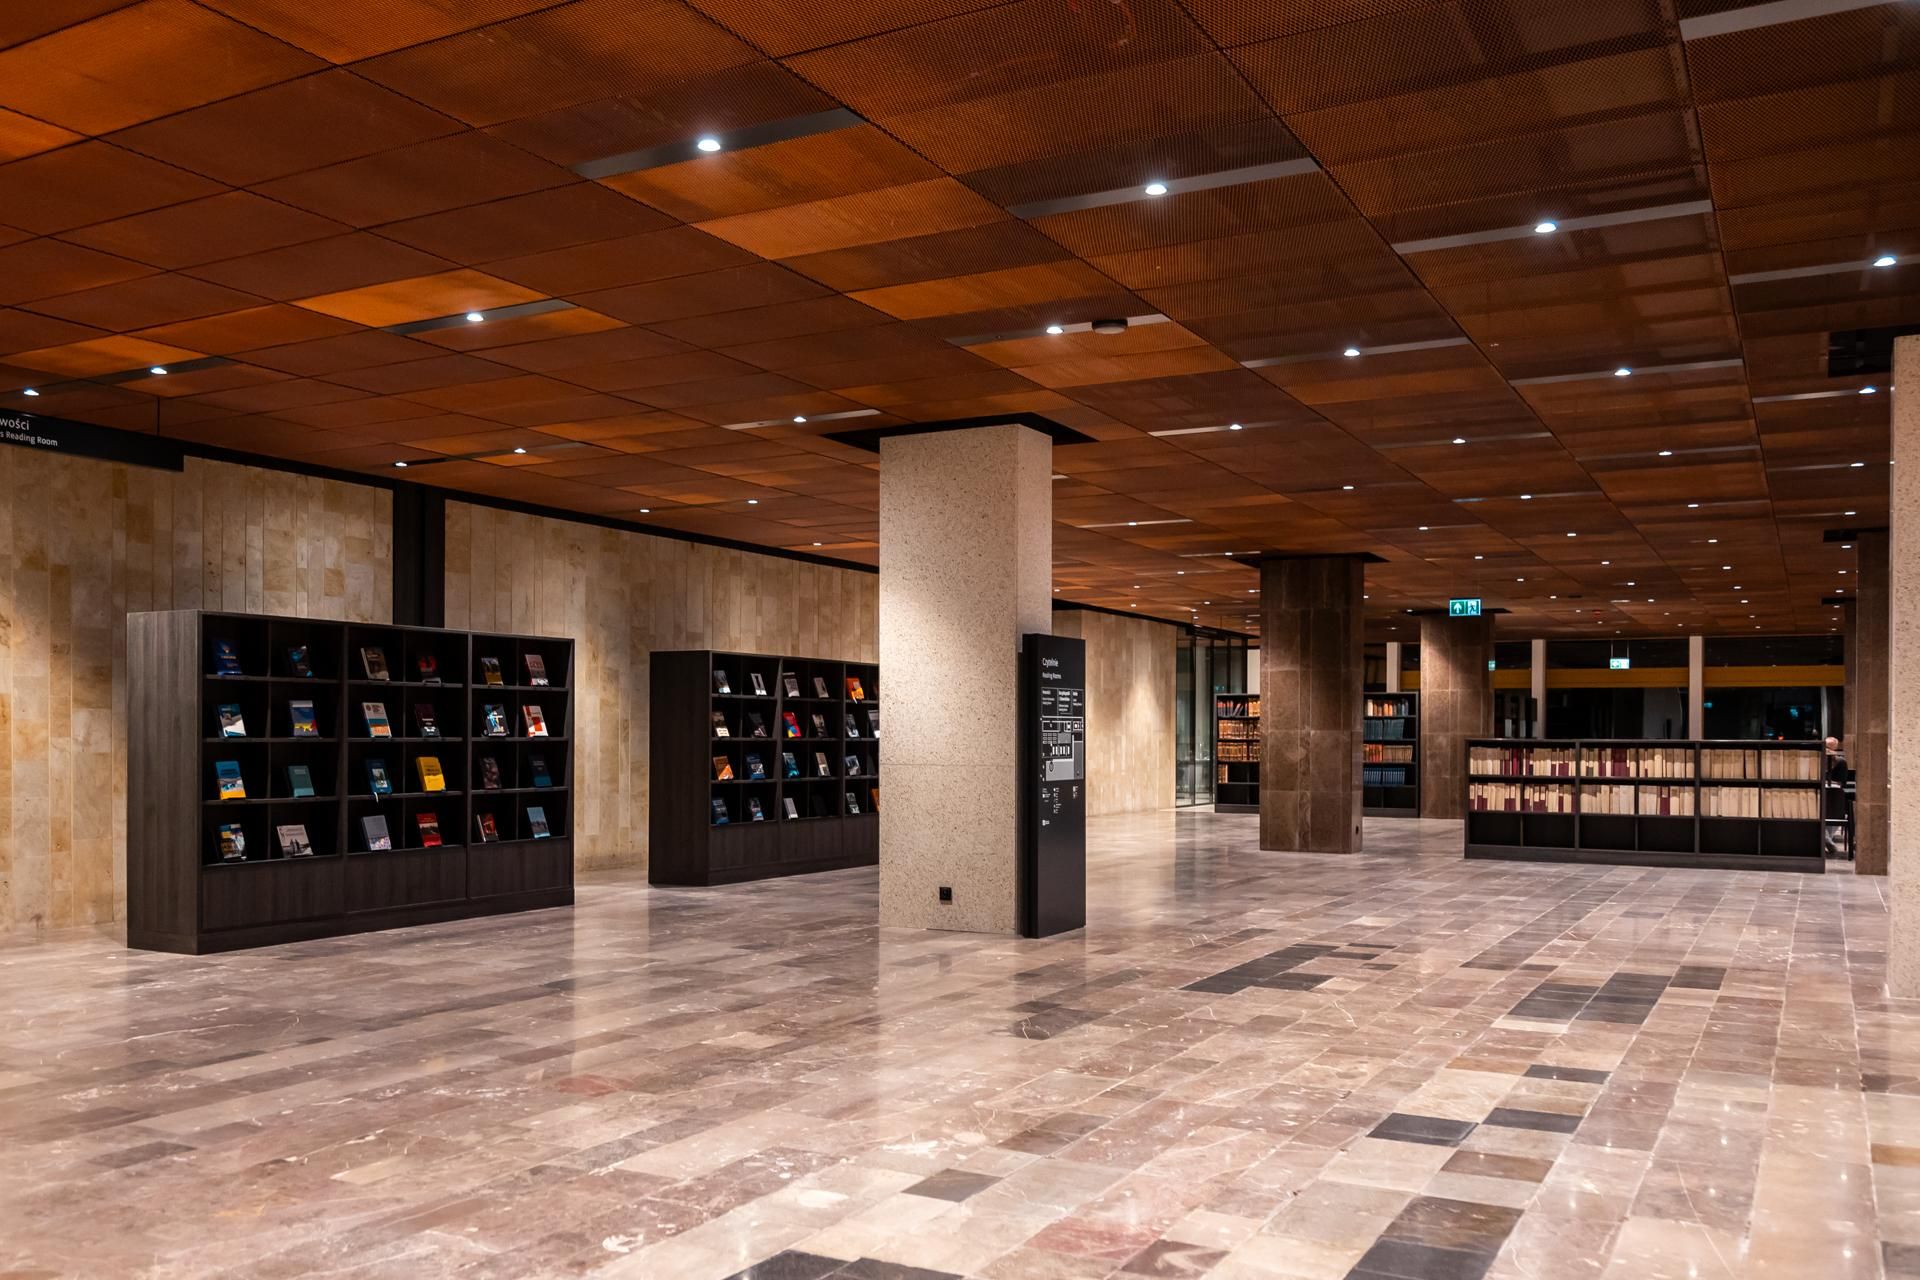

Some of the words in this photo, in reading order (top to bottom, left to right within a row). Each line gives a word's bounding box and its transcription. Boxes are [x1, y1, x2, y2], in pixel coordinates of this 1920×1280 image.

[0, 418, 30, 431] wości
[6, 431, 36, 444] Reading
[37, 436, 58, 447] Room
